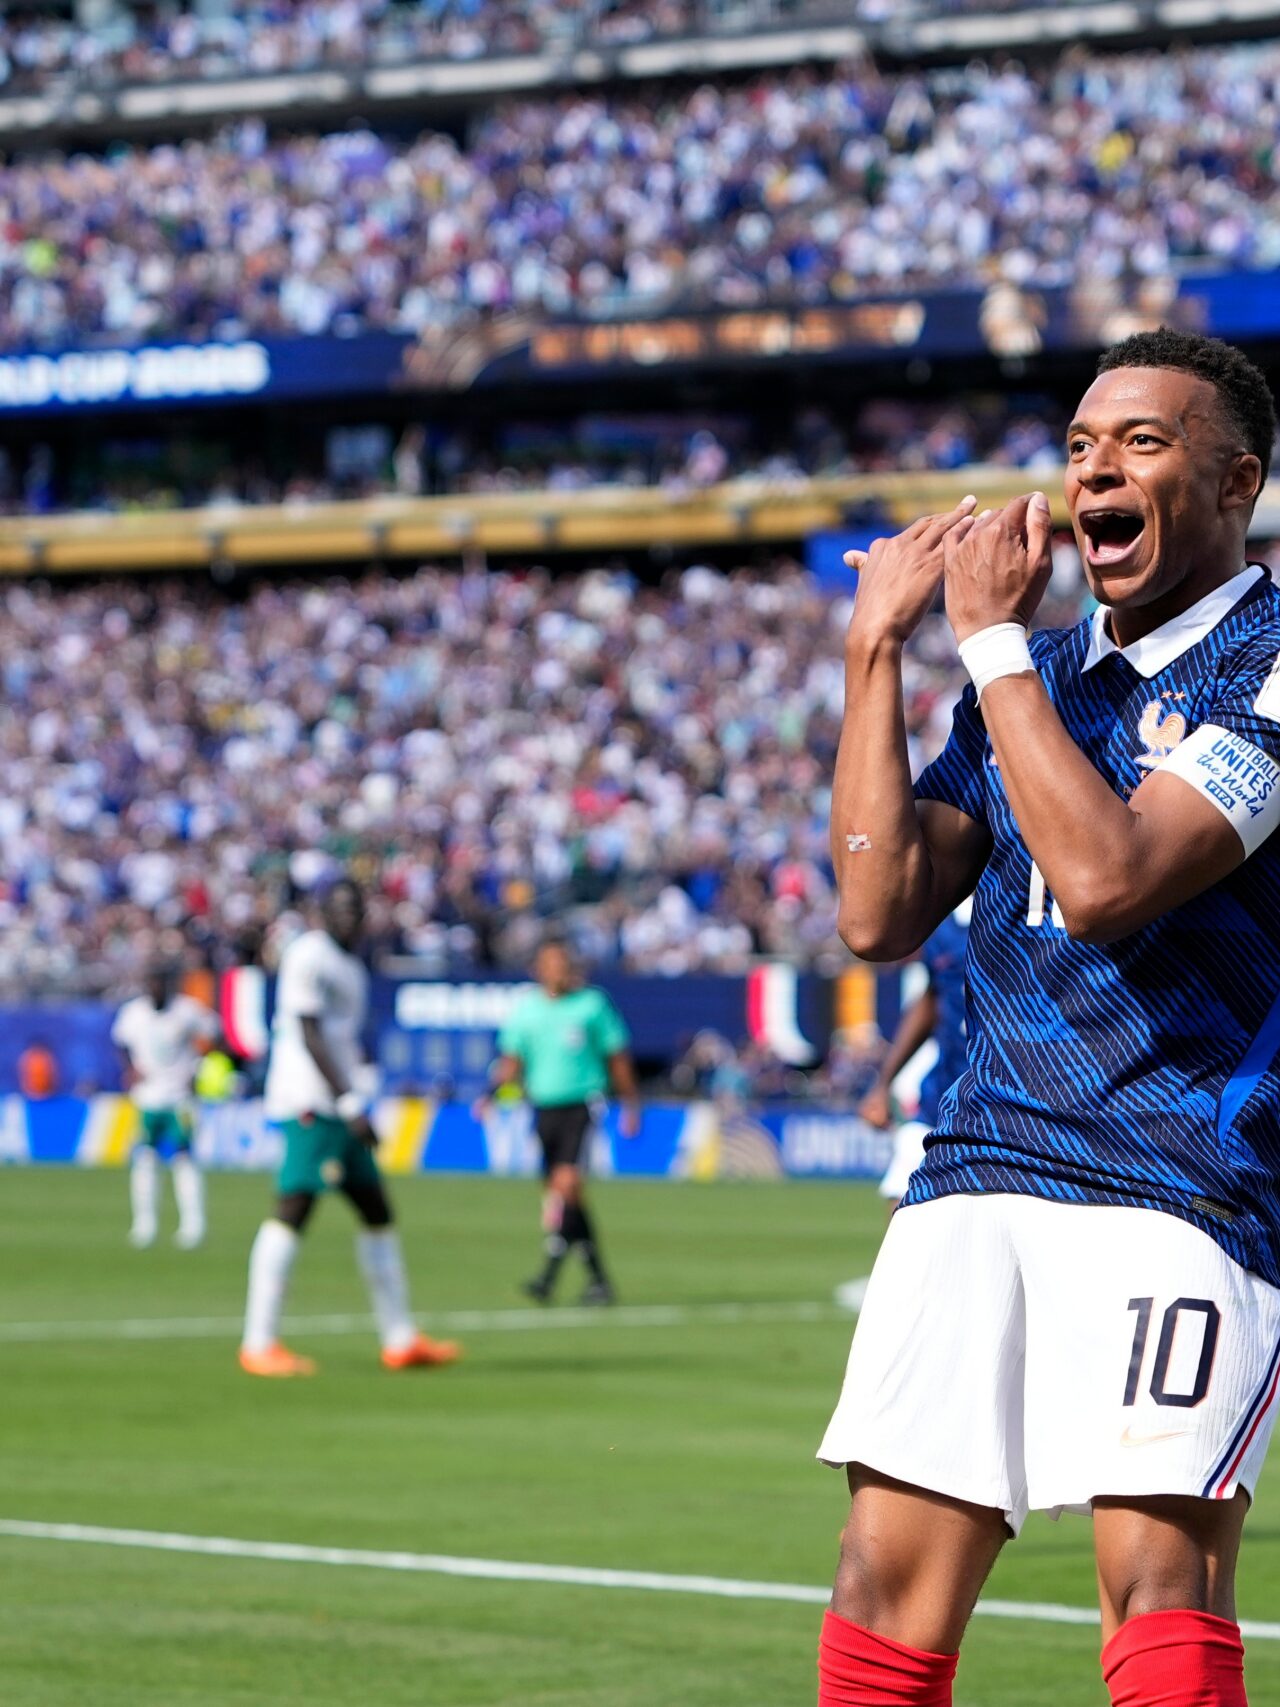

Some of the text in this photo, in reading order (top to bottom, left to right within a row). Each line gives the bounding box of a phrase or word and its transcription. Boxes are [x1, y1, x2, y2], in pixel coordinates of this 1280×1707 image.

[1196, 753, 1265, 818] the World
[1205, 780, 1236, 810] FIFA
[1211, 739, 1273, 801] UNITES
[1123, 1297, 1222, 1408] 10
